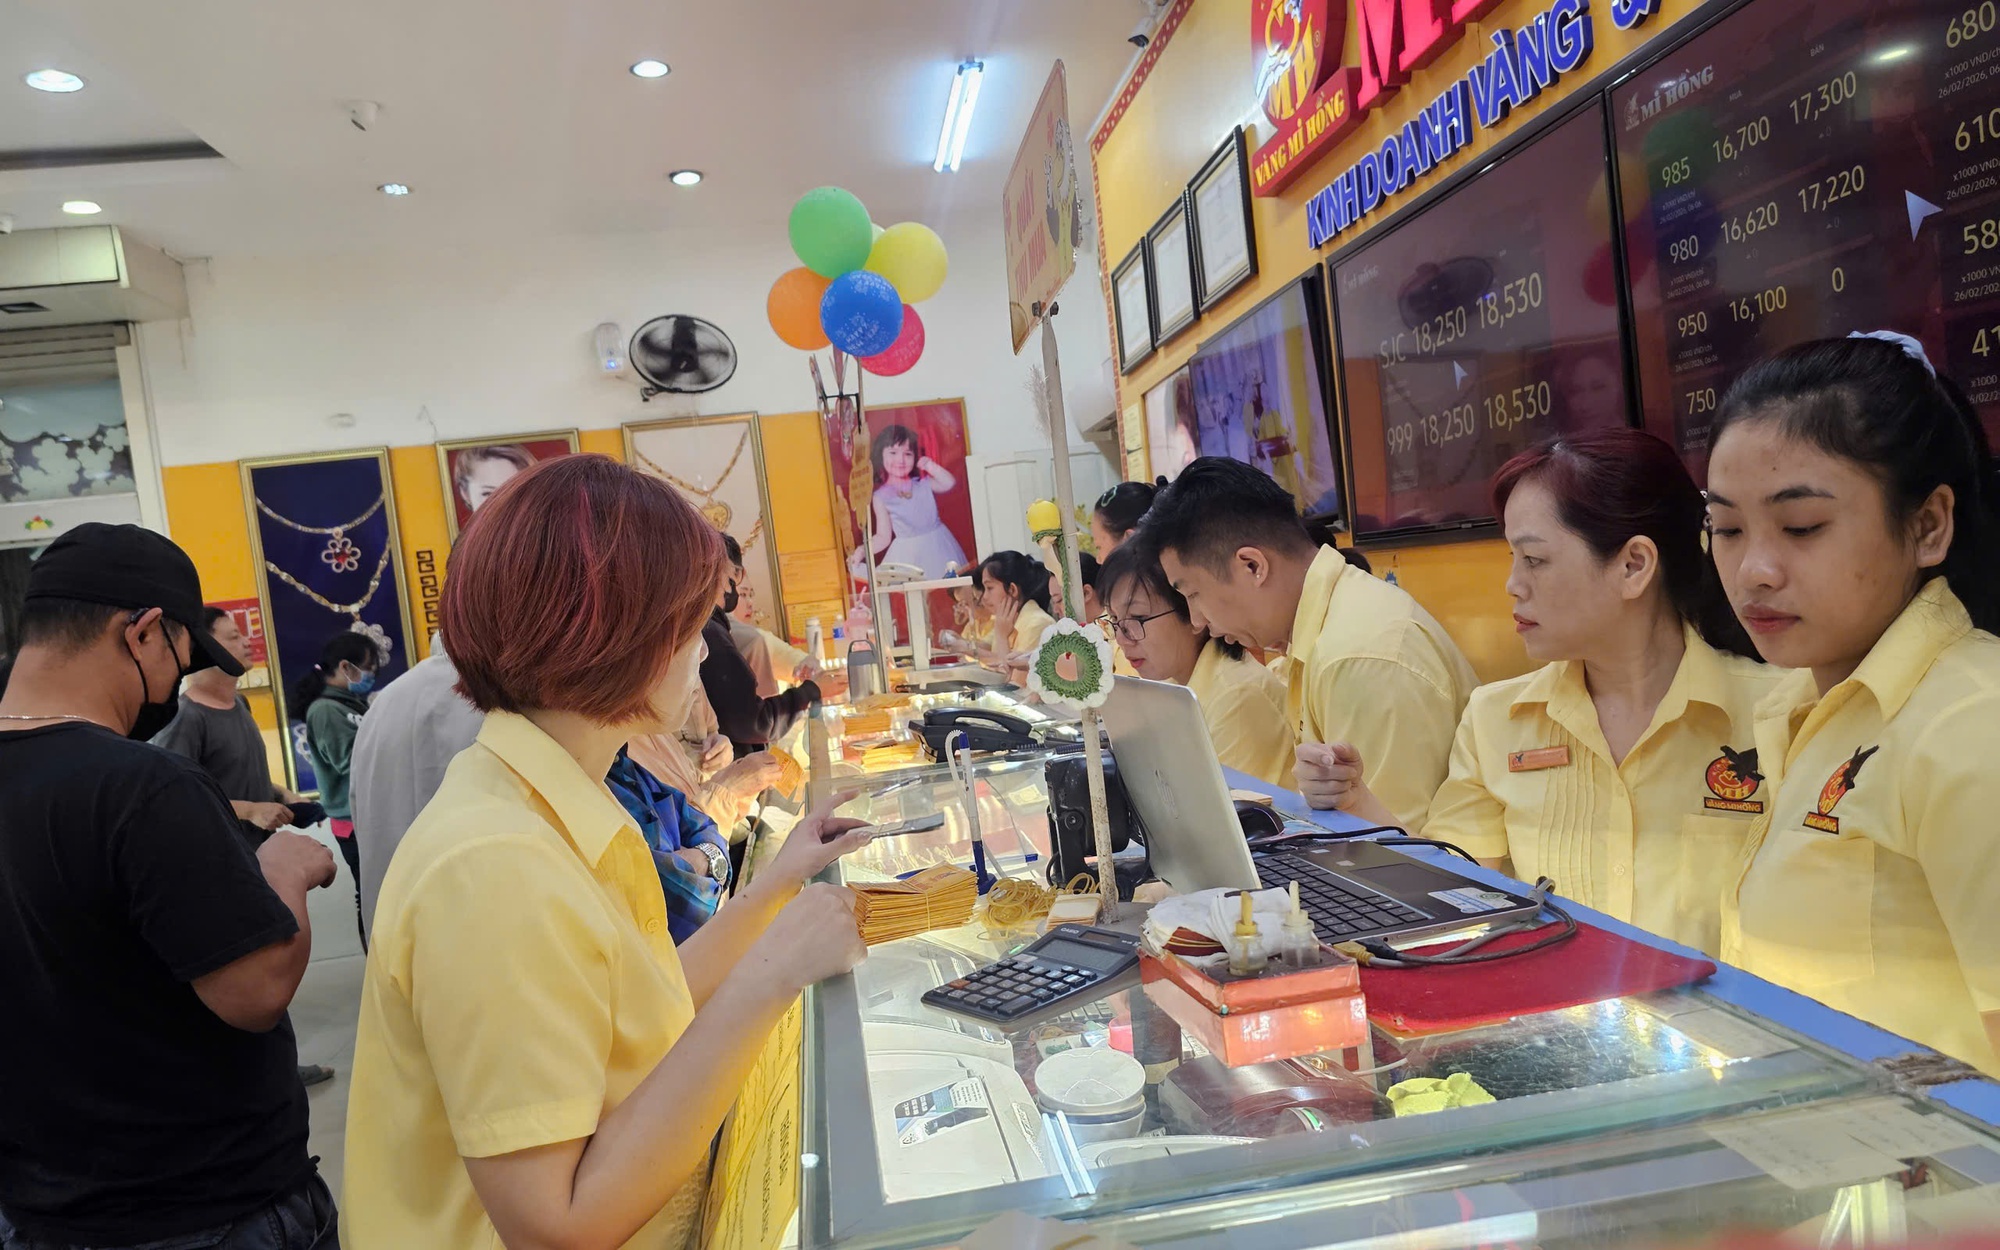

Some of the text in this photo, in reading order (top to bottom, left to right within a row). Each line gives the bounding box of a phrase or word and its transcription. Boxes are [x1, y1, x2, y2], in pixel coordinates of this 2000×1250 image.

[1946, 1, 1996, 48] 680
[1665, 65, 1714, 108] HỒNG
[1938, 70, 1988, 98] 26/02/2026,
[1945, 61, 1969, 80] x1000
[1254, 144, 1287, 188] VÀNG
[1305, 88, 1345, 145] HỒNG
[1305, 0, 1586, 250] KINH DOANH VÀNG
[1662, 71, 1857, 188] 985 16,700 17,300
[1955, 107, 2000, 151] 610
[1946, 176, 1998, 200] 26/02/2026,
[1953, 164, 1978, 182] x1000
[1669, 165, 1865, 264] 980 16,620 17,220
[1963, 219, 2000, 255] 58
[1961, 268, 1988, 284] x1000
[1380, 272, 1543, 369] SJC 18,250 18,530
[1678, 267, 1844, 338] 950 16,100 0
[1387, 381, 1551, 456] 999 18,250 18,530
[1685, 388, 1716, 415] 750
